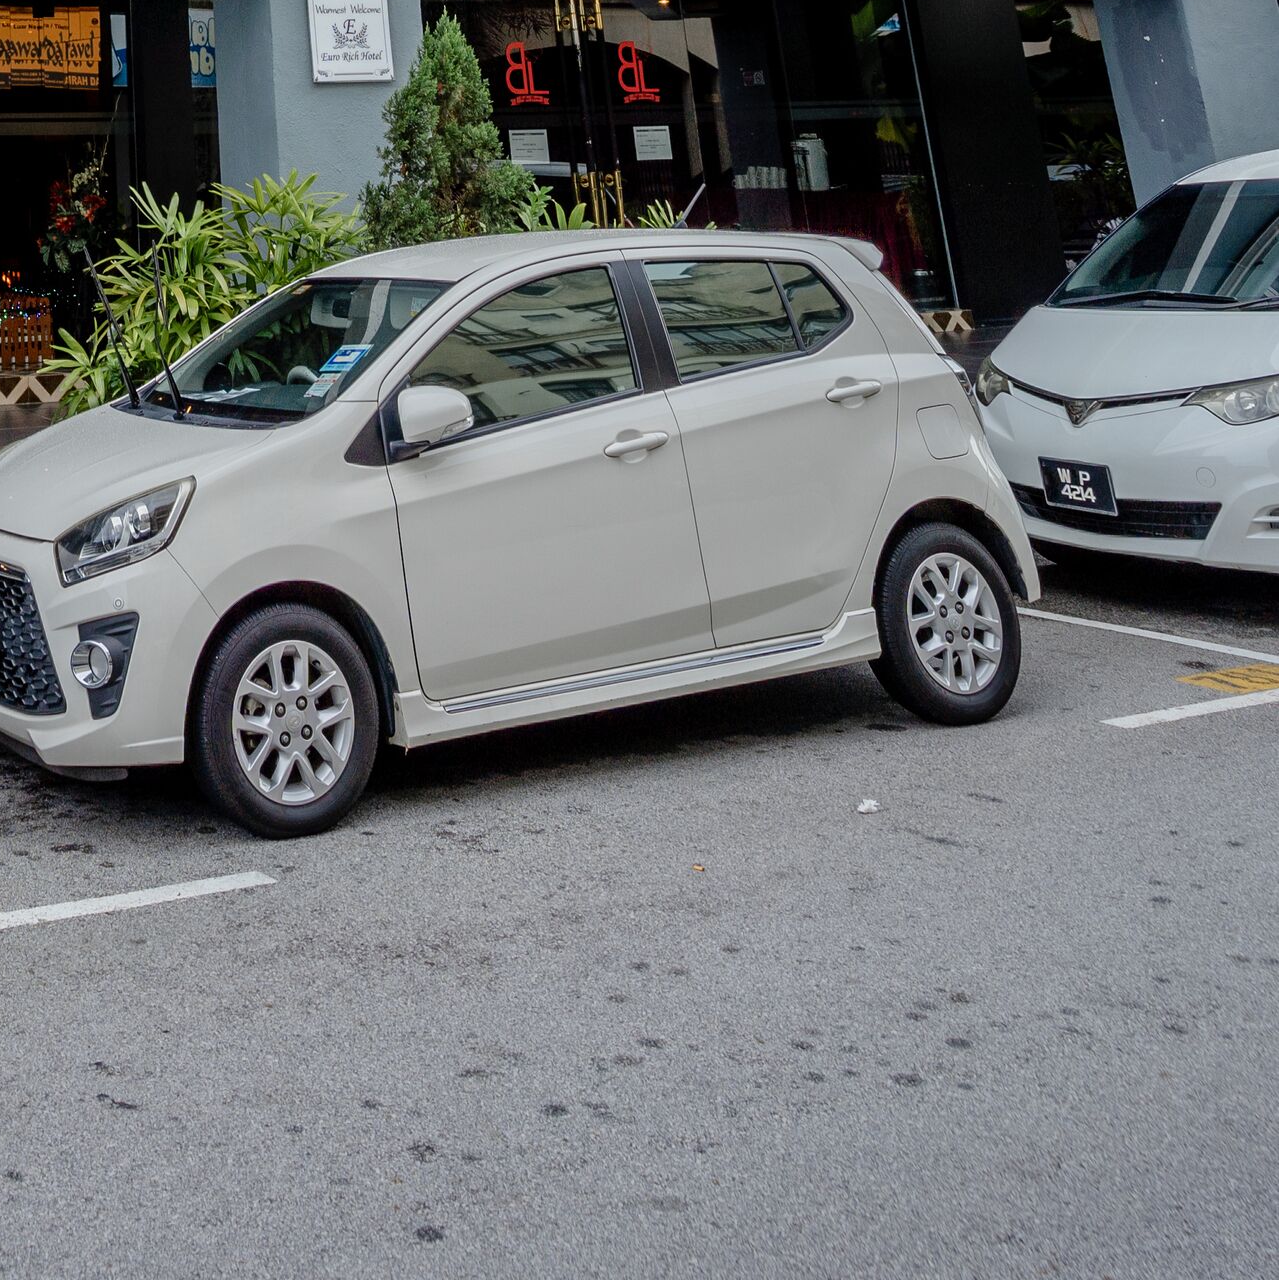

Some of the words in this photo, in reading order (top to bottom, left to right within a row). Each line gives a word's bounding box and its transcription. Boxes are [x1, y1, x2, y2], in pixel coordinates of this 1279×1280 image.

[315, 5, 347, 15] Warmest
[350, 3, 382, 15] Welcome
[321, 52, 341, 62] Euro
[341, 50, 360, 63] Rich
[360, 50, 383, 61] Hotel
[1056, 467, 1072, 484] W
[1078, 470, 1091, 486] P
[1061, 484, 1097, 503] 4214
